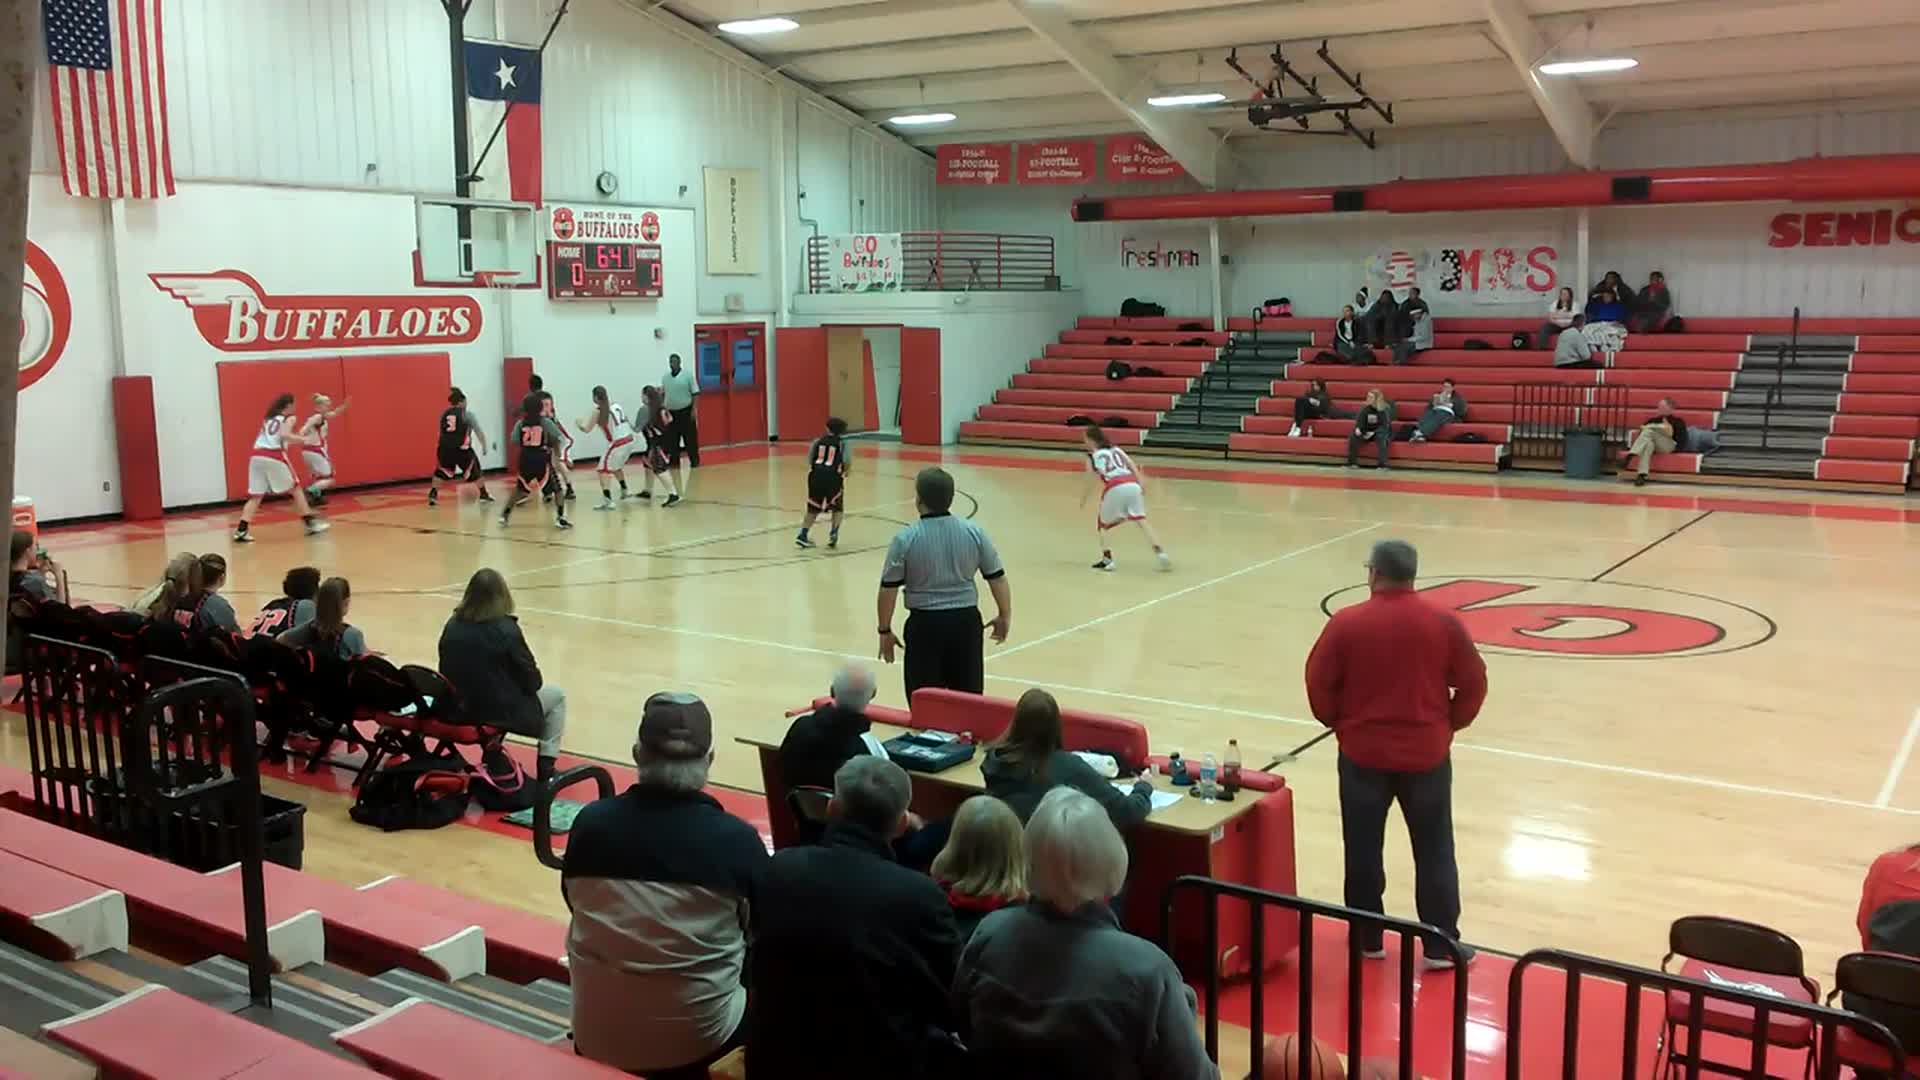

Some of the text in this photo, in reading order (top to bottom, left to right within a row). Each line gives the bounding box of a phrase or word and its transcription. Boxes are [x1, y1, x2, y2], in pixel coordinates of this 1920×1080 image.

[577, 221, 640, 239] BUFFALOES
[557, 246, 581, 258] HOME
[1120, 239, 1200, 268] Freshman
[571, 262, 583, 287] 0
[224, 295, 470, 345] BUFFALOES
[815, 444, 837, 466] 11
[1099, 449, 1126, 473] 20
[243, 608, 287, 637] 22
